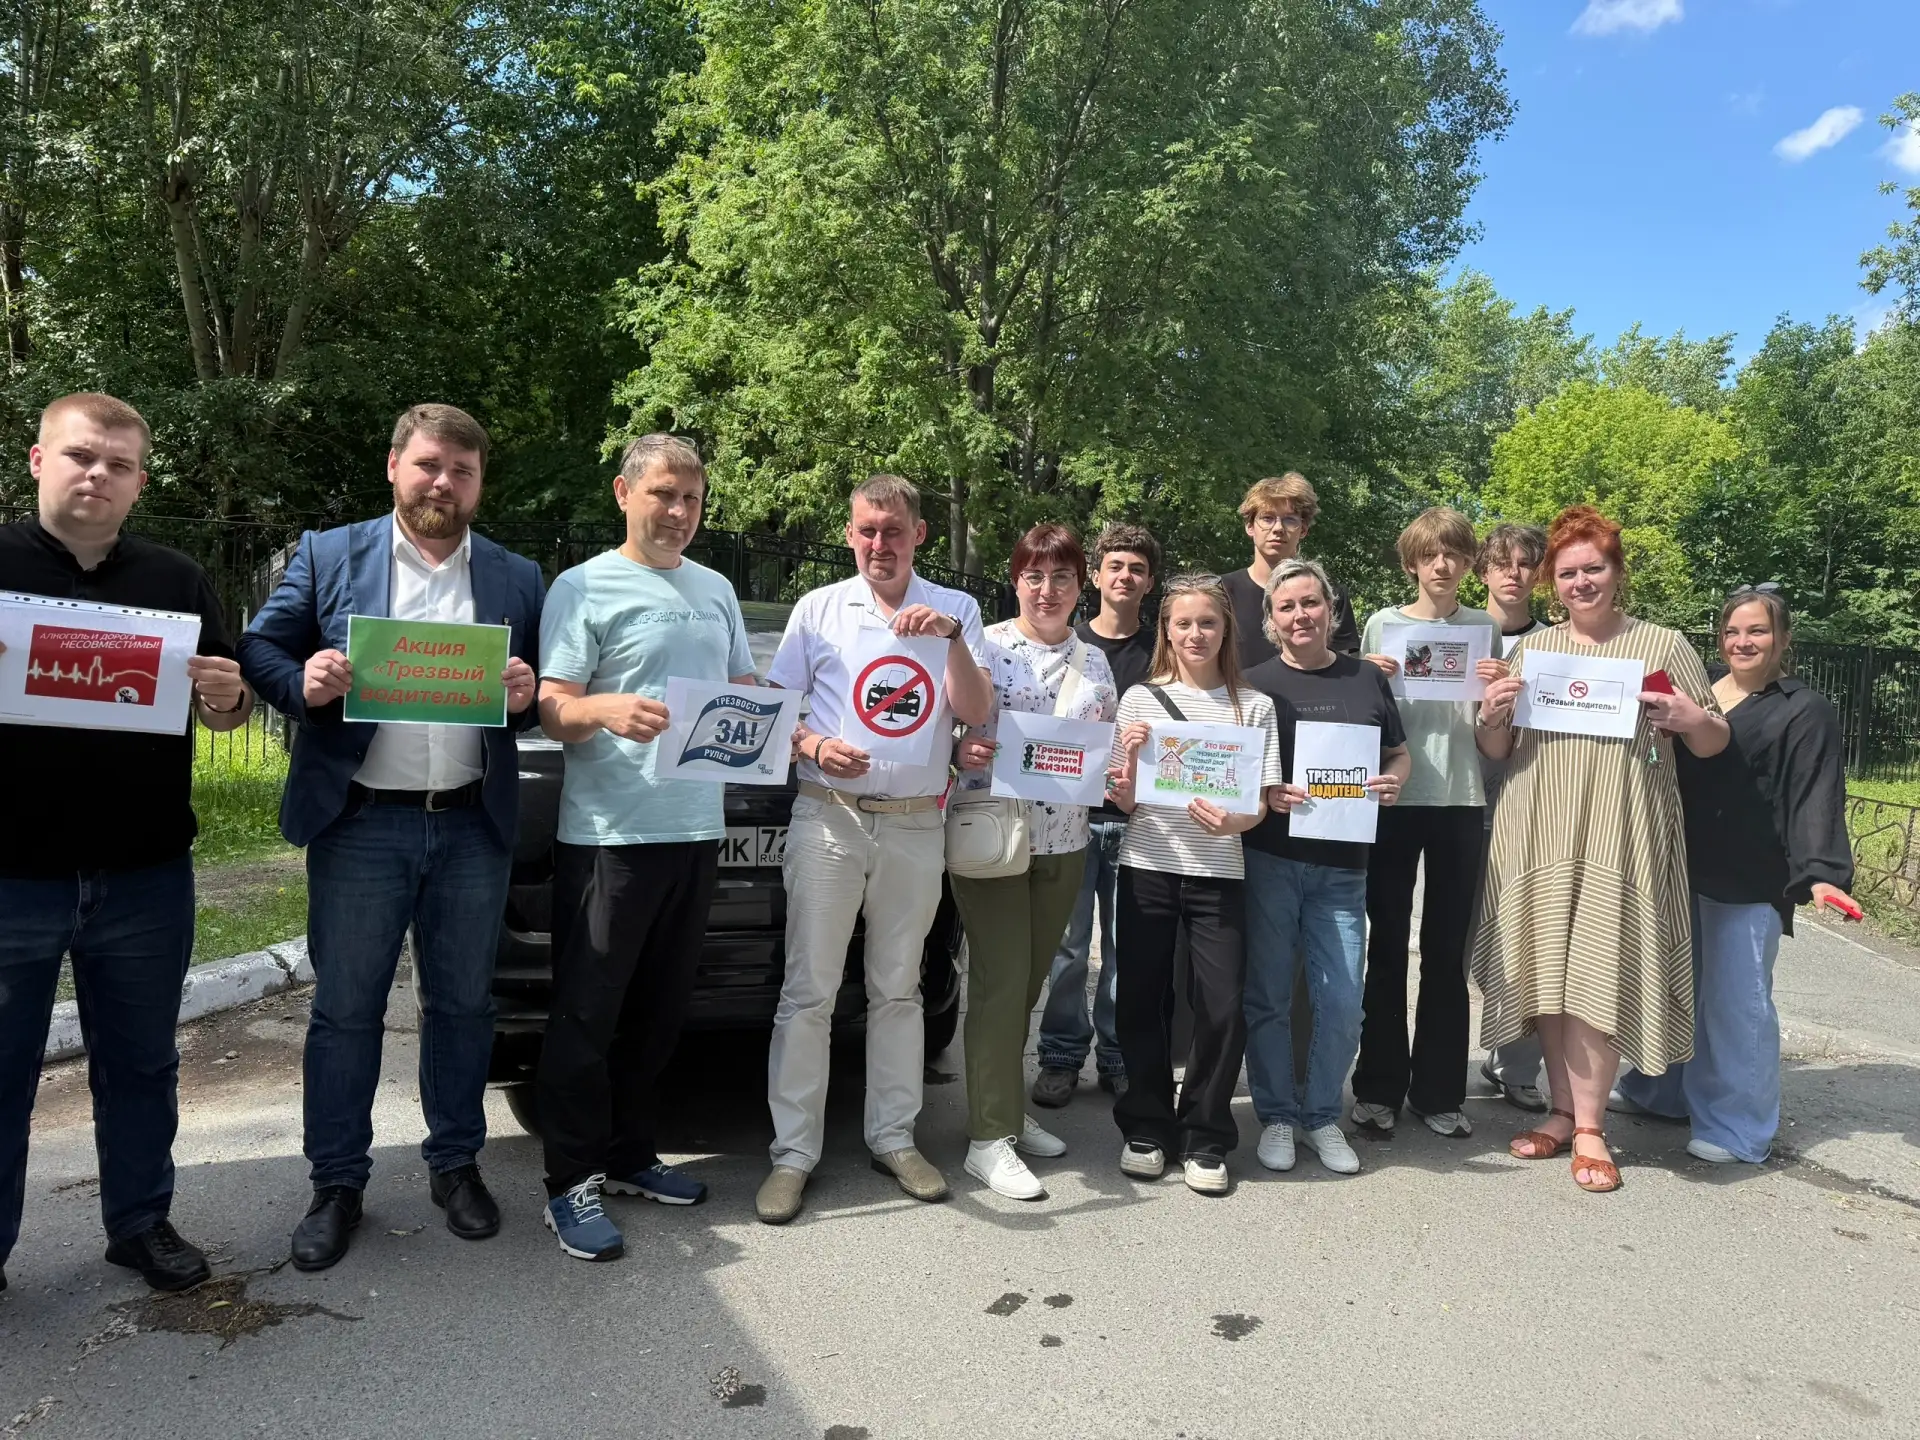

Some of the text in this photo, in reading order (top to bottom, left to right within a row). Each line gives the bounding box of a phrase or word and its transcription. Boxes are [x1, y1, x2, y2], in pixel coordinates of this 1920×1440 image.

[40, 632, 89, 640] АЛКОГОЛЬ
[393, 637, 466, 656] Акция
[373, 660, 485, 681] «Трезвый
[715, 696, 761, 713] ТРЕЗВОСТЬ
[1537, 695, 1616, 711] «Трезвый водитель»
[715, 719, 758, 746] ЗА!
[704, 748, 731, 763] РУЛЕМ
[1036, 744, 1079, 756] Трезвым
[1309, 784, 1365, 799] ВОДИТЕЛЬ
[760, 854, 784, 862] RUS
